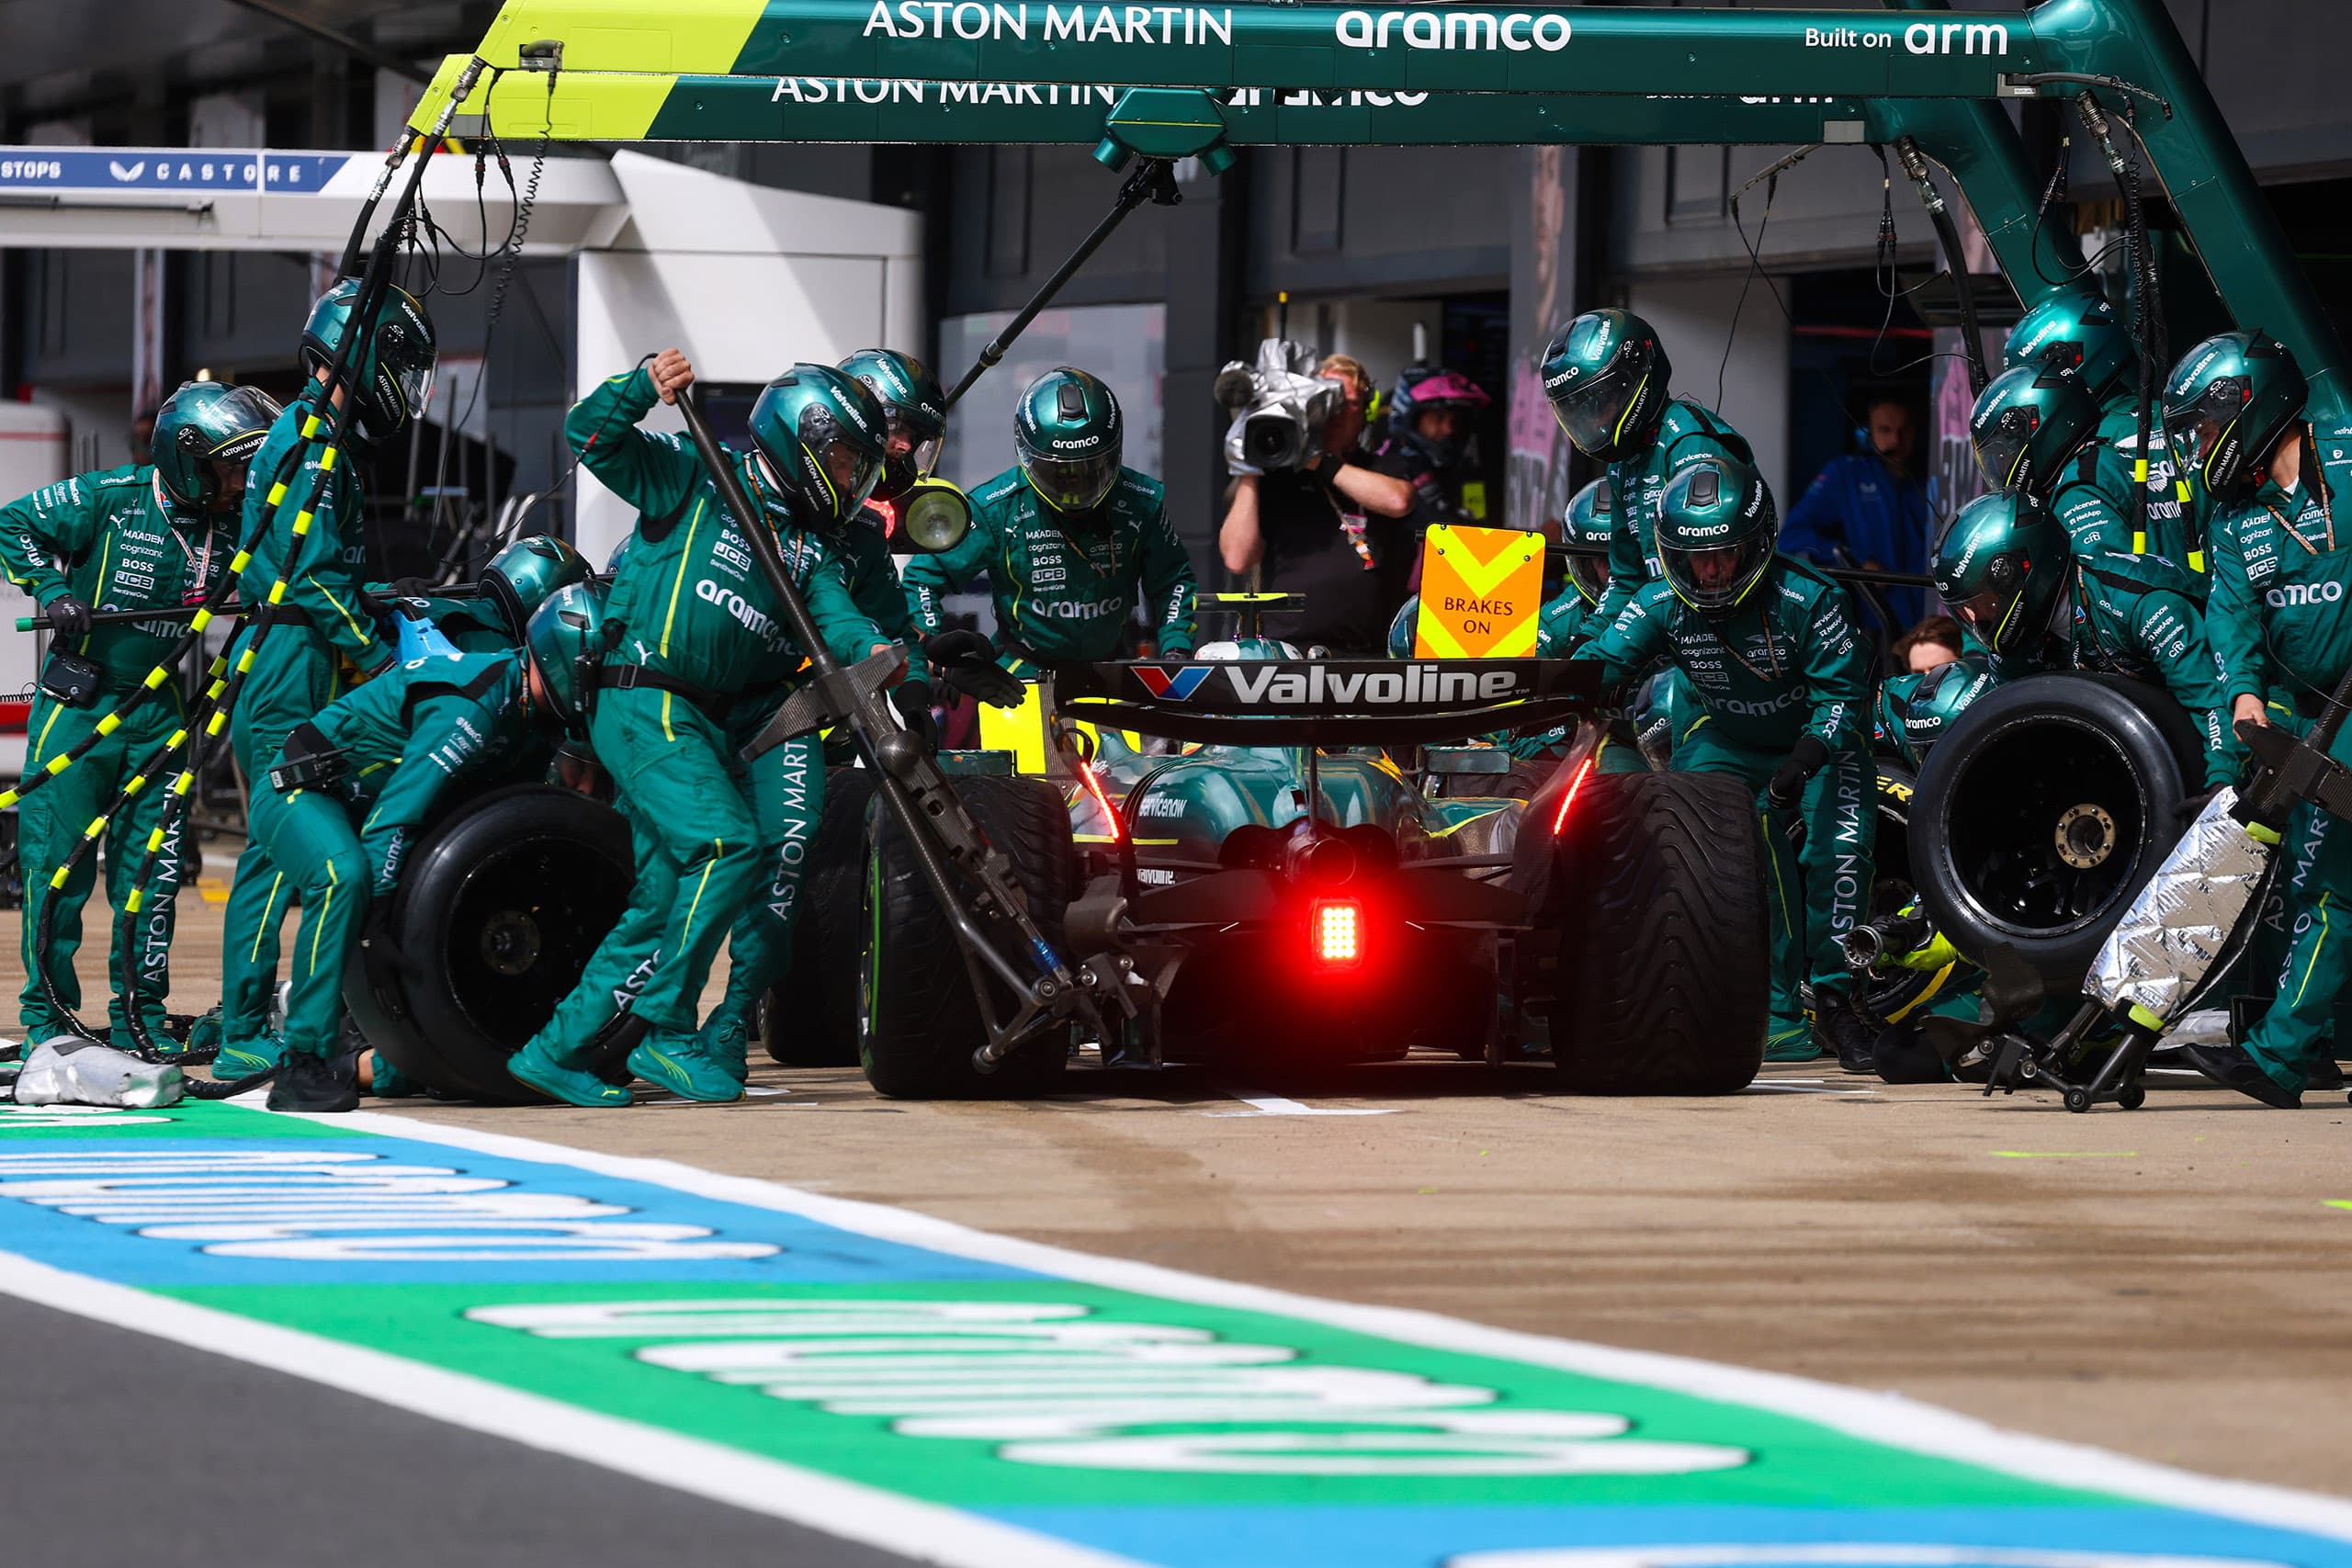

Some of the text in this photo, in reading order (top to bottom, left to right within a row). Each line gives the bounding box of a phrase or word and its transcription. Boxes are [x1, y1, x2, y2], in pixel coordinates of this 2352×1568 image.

[863, 0, 1232, 46] ASTON MARTIN
[1335, 10, 1572, 51] aramco
[1805, 23, 2009, 56] Built on arm
[156, 163, 300, 183] CASTORE
[1544, 367, 1579, 389] aramco
[921, 401, 944, 422] aram
[221, 445, 244, 457] ASTON
[1052, 435, 1100, 449] aramco
[2221, 439, 2239, 468] MARTIN
[802, 456, 820, 479] ASTON
[1678, 524, 1729, 536] aramco
[119, 543, 164, 558] cognizant
[1033, 555, 1062, 566] BOSS
[2243, 543, 2273, 561] BOSS
[121, 558, 155, 572] BOSS
[1031, 567, 1067, 583] JCB
[114, 570, 154, 590] JCB
[1032, 597, 1122, 620] aramco
[1444, 597, 1514, 616] BRAKES
[1464, 619, 1491, 635] ON
[1690, 660, 1723, 670] BOSS
[1225, 665, 1517, 705] Valvoline
[1905, 716, 1941, 729] aramco
[1836, 750, 1860, 843] MARTIN
[768, 736, 808, 920] ASTON MART
[143, 892, 174, 983] ASTON
